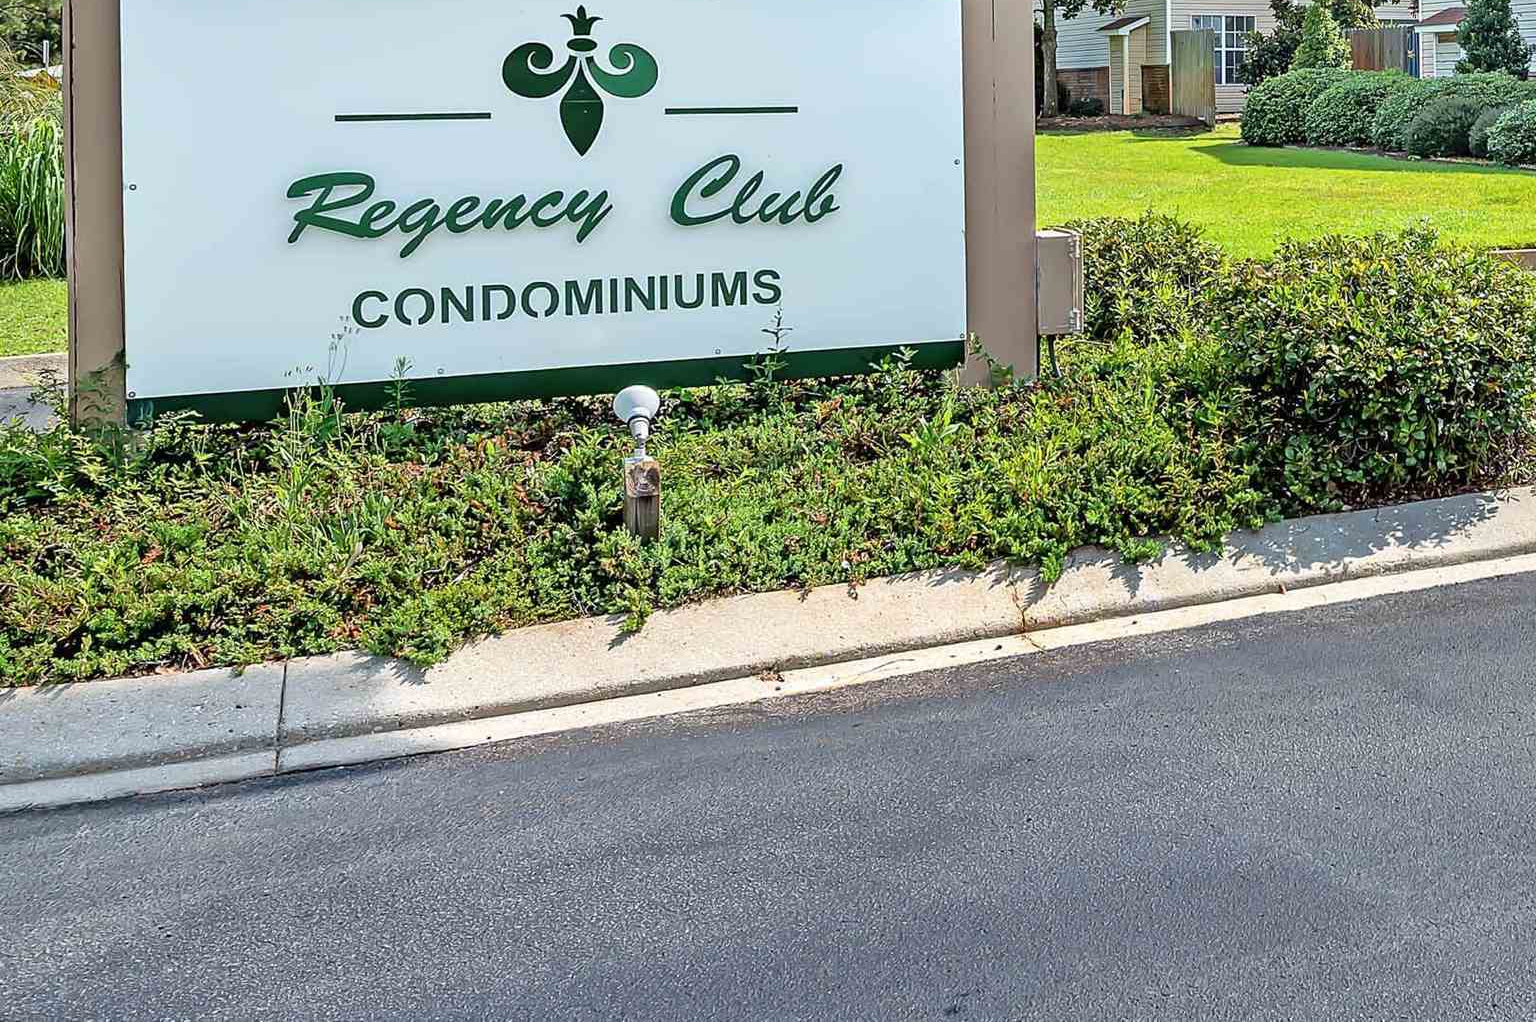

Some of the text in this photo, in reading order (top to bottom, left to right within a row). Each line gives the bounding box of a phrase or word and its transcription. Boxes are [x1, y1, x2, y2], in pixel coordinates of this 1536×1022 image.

[286, 153, 843, 259] Regency Club
[351, 269, 783, 329] CONDOMINIUMS
